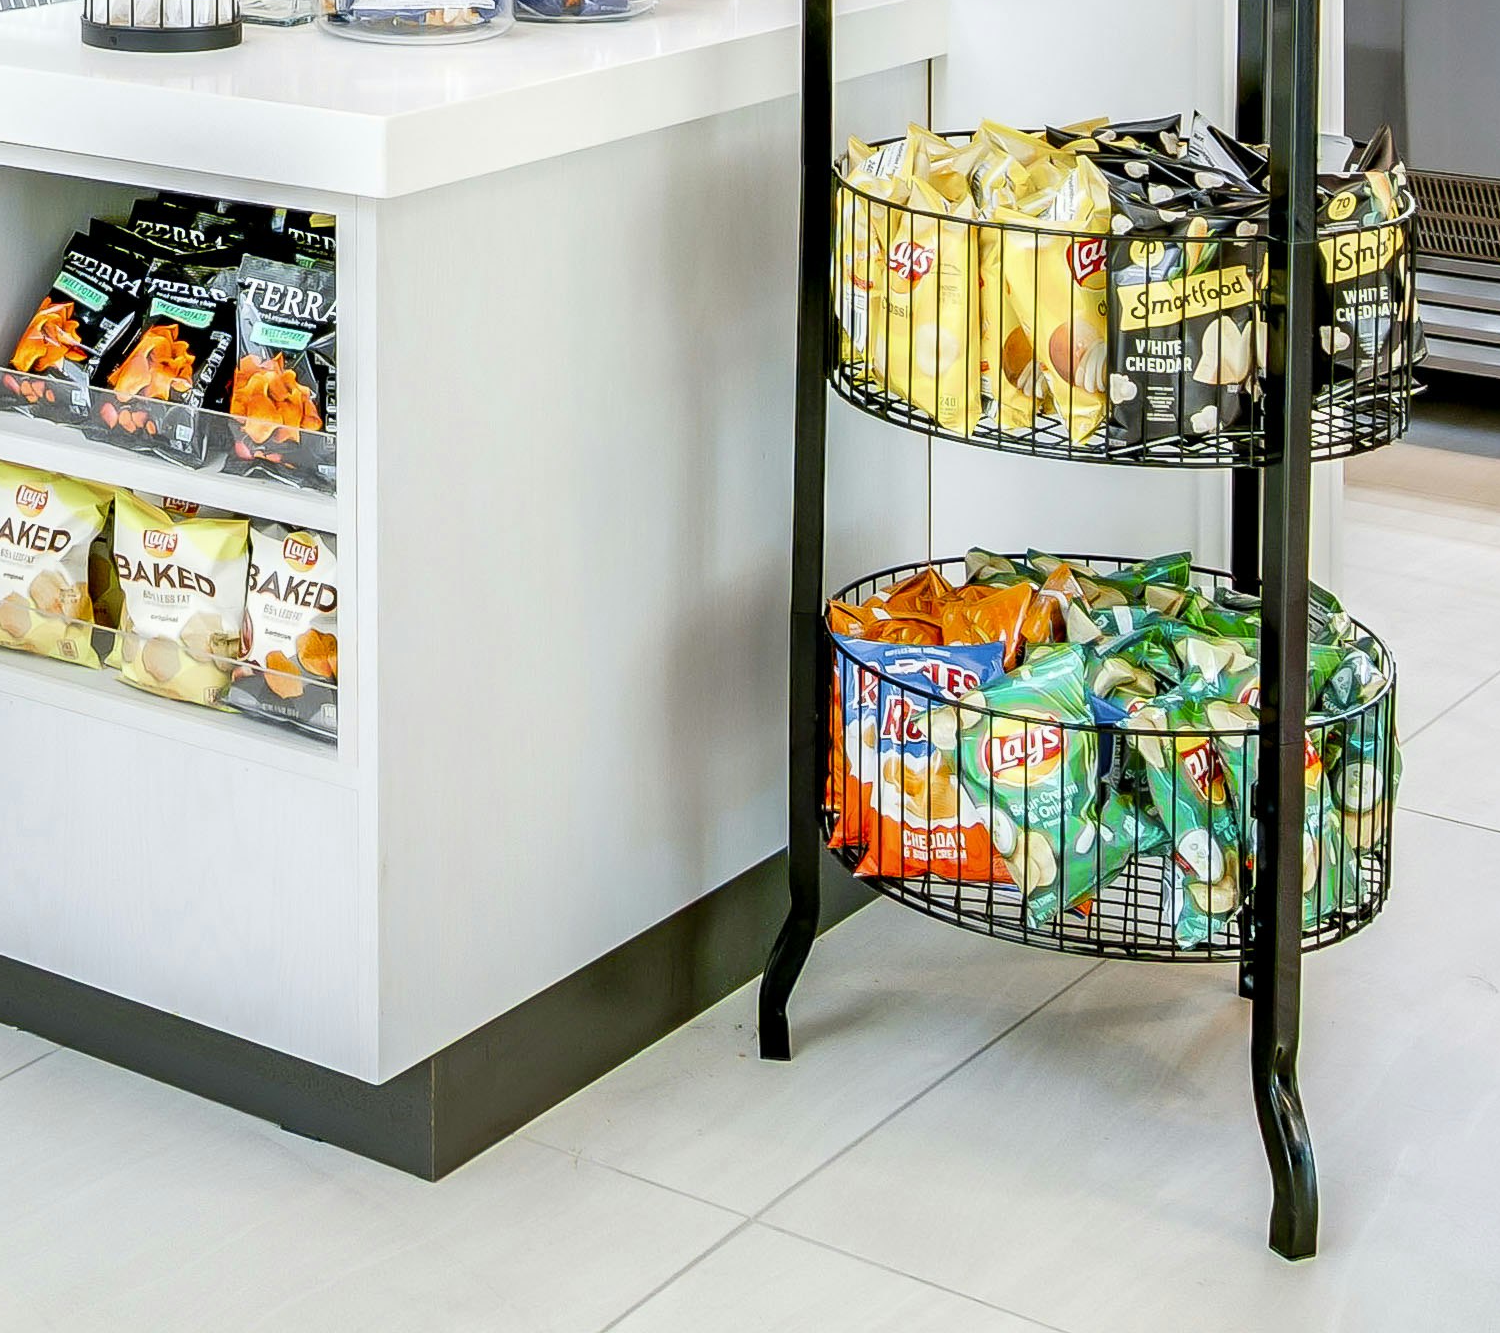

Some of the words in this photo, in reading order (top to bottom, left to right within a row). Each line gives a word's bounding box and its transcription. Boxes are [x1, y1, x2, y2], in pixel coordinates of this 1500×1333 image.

[1336, 196, 1351, 211] 70
[1131, 276, 1247, 320] Smartfood
[1343, 286, 1390, 305] WHITE
[1135, 337, 1183, 356] WHITE
[1126, 356, 1193, 374] CHEDDAR
[115, 553, 216, 598] BAKED
[249, 563, 337, 613] BAKED
